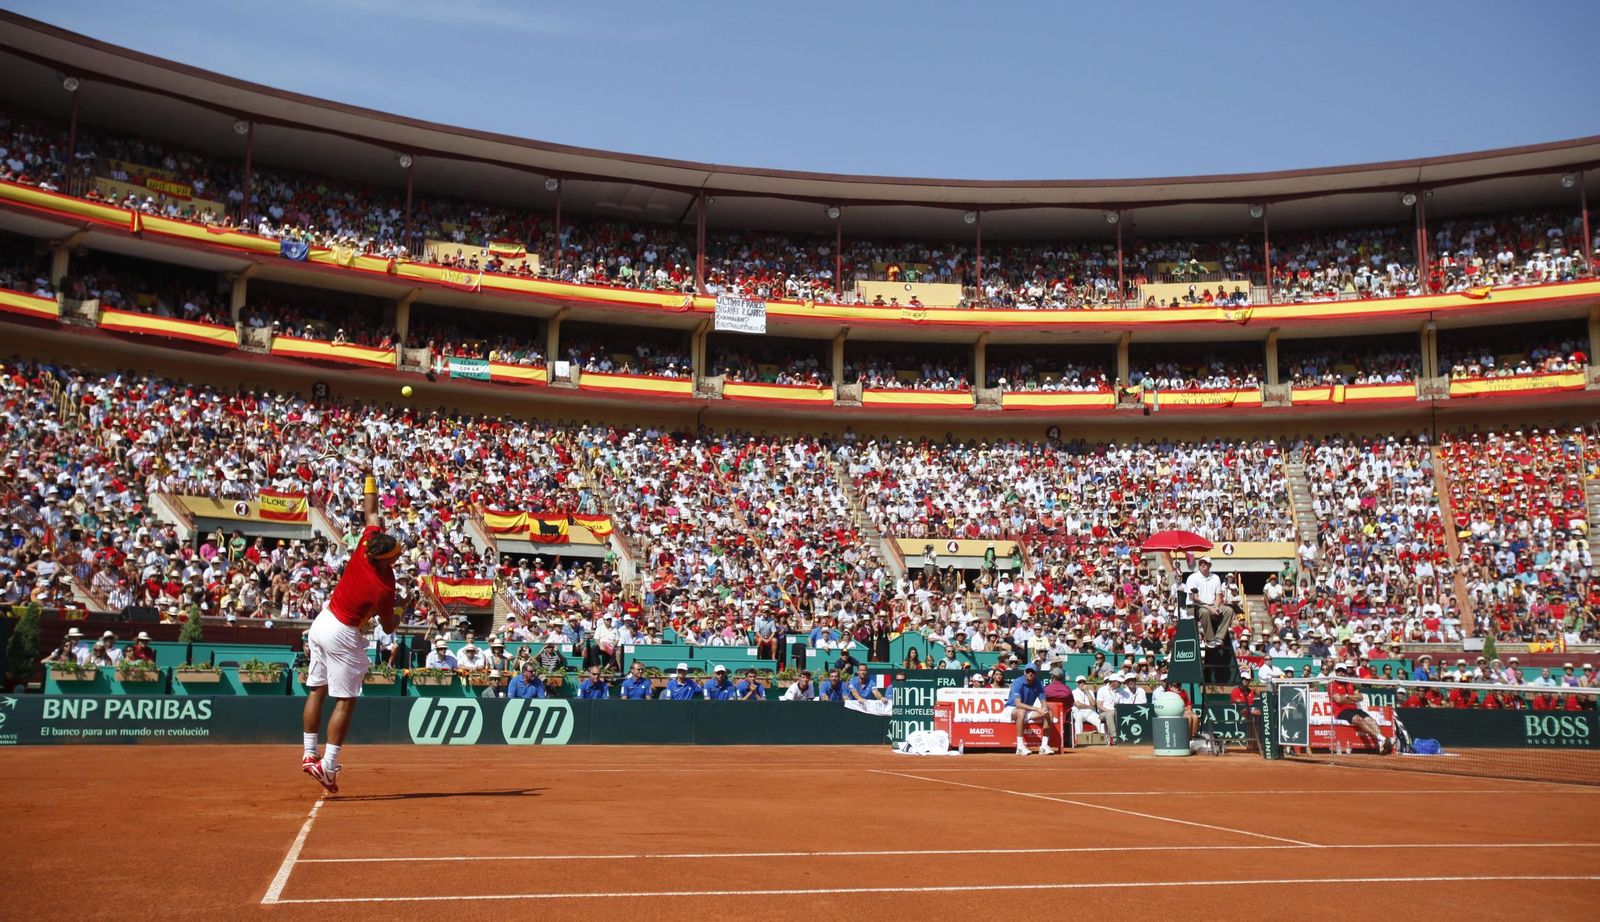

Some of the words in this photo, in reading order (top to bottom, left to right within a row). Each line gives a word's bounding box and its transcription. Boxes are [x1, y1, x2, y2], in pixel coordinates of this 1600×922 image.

[316, 383, 326, 396] 3
[1049, 427, 1058, 439] 4
[261, 495, 287, 507] ELCHE
[238, 503, 247, 516] 3
[949, 542, 957, 552] 4
[1224, 543, 1233, 554] 4
[1176, 650, 1194, 659] Adecco
[937, 678, 956, 686] FRA
[42, 699, 98, 719] BNP
[104, 699, 212, 720] PARIBAS
[1262, 692, 1270, 737] PARIBAS
[416, 697, 476, 744] hp
[510, 698, 567, 745] hp
[1525, 715, 1589, 737] BOSS
[41, 727, 49, 736] El
[52, 727, 80, 736] banco
[82, 729, 102, 738] para
[120, 727, 151, 736] mundo
[167, 726, 209, 736] evolución
